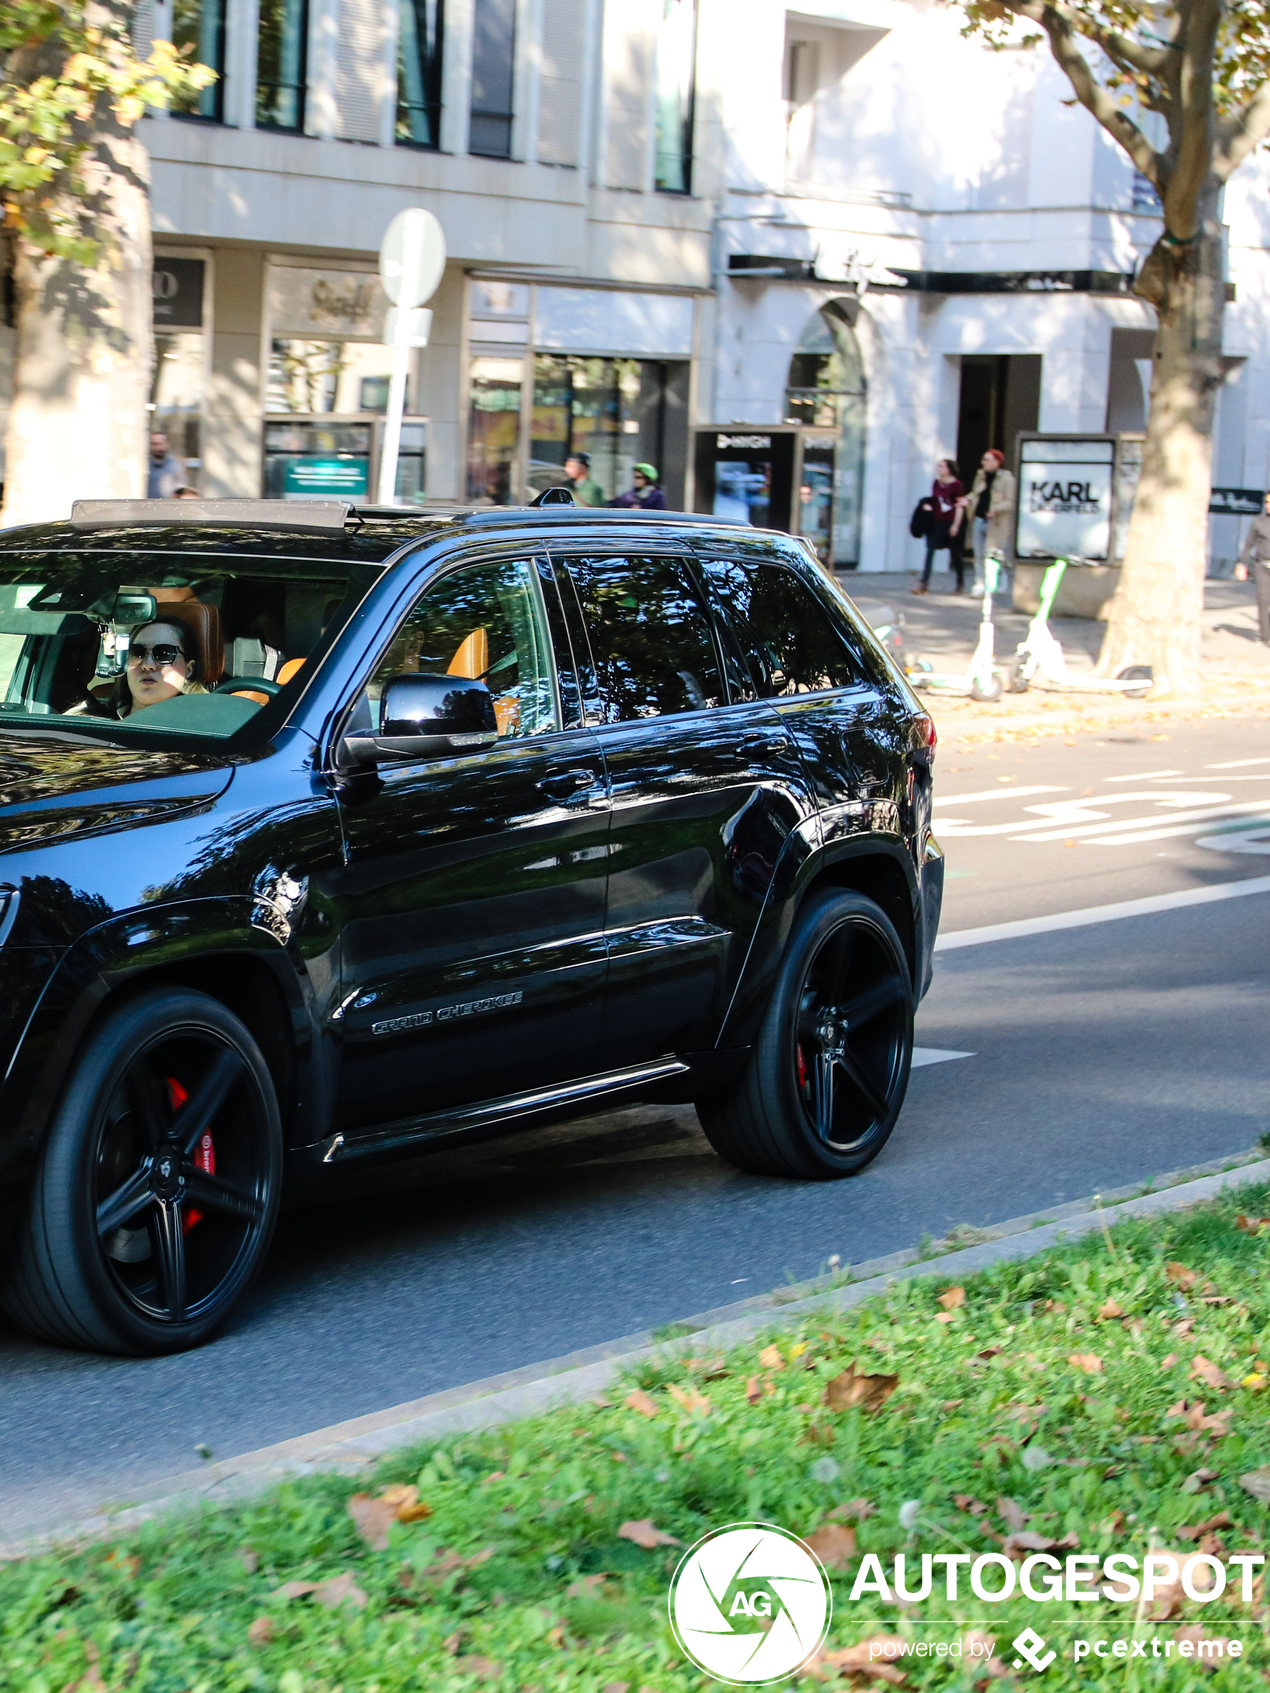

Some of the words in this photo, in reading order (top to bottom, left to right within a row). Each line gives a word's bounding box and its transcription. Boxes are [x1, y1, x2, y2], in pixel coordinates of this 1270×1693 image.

[1031, 482, 1098, 503] KARL
[371, 1011, 433, 1035] GRAND
[436, 991, 523, 1021] CHEROKEE
